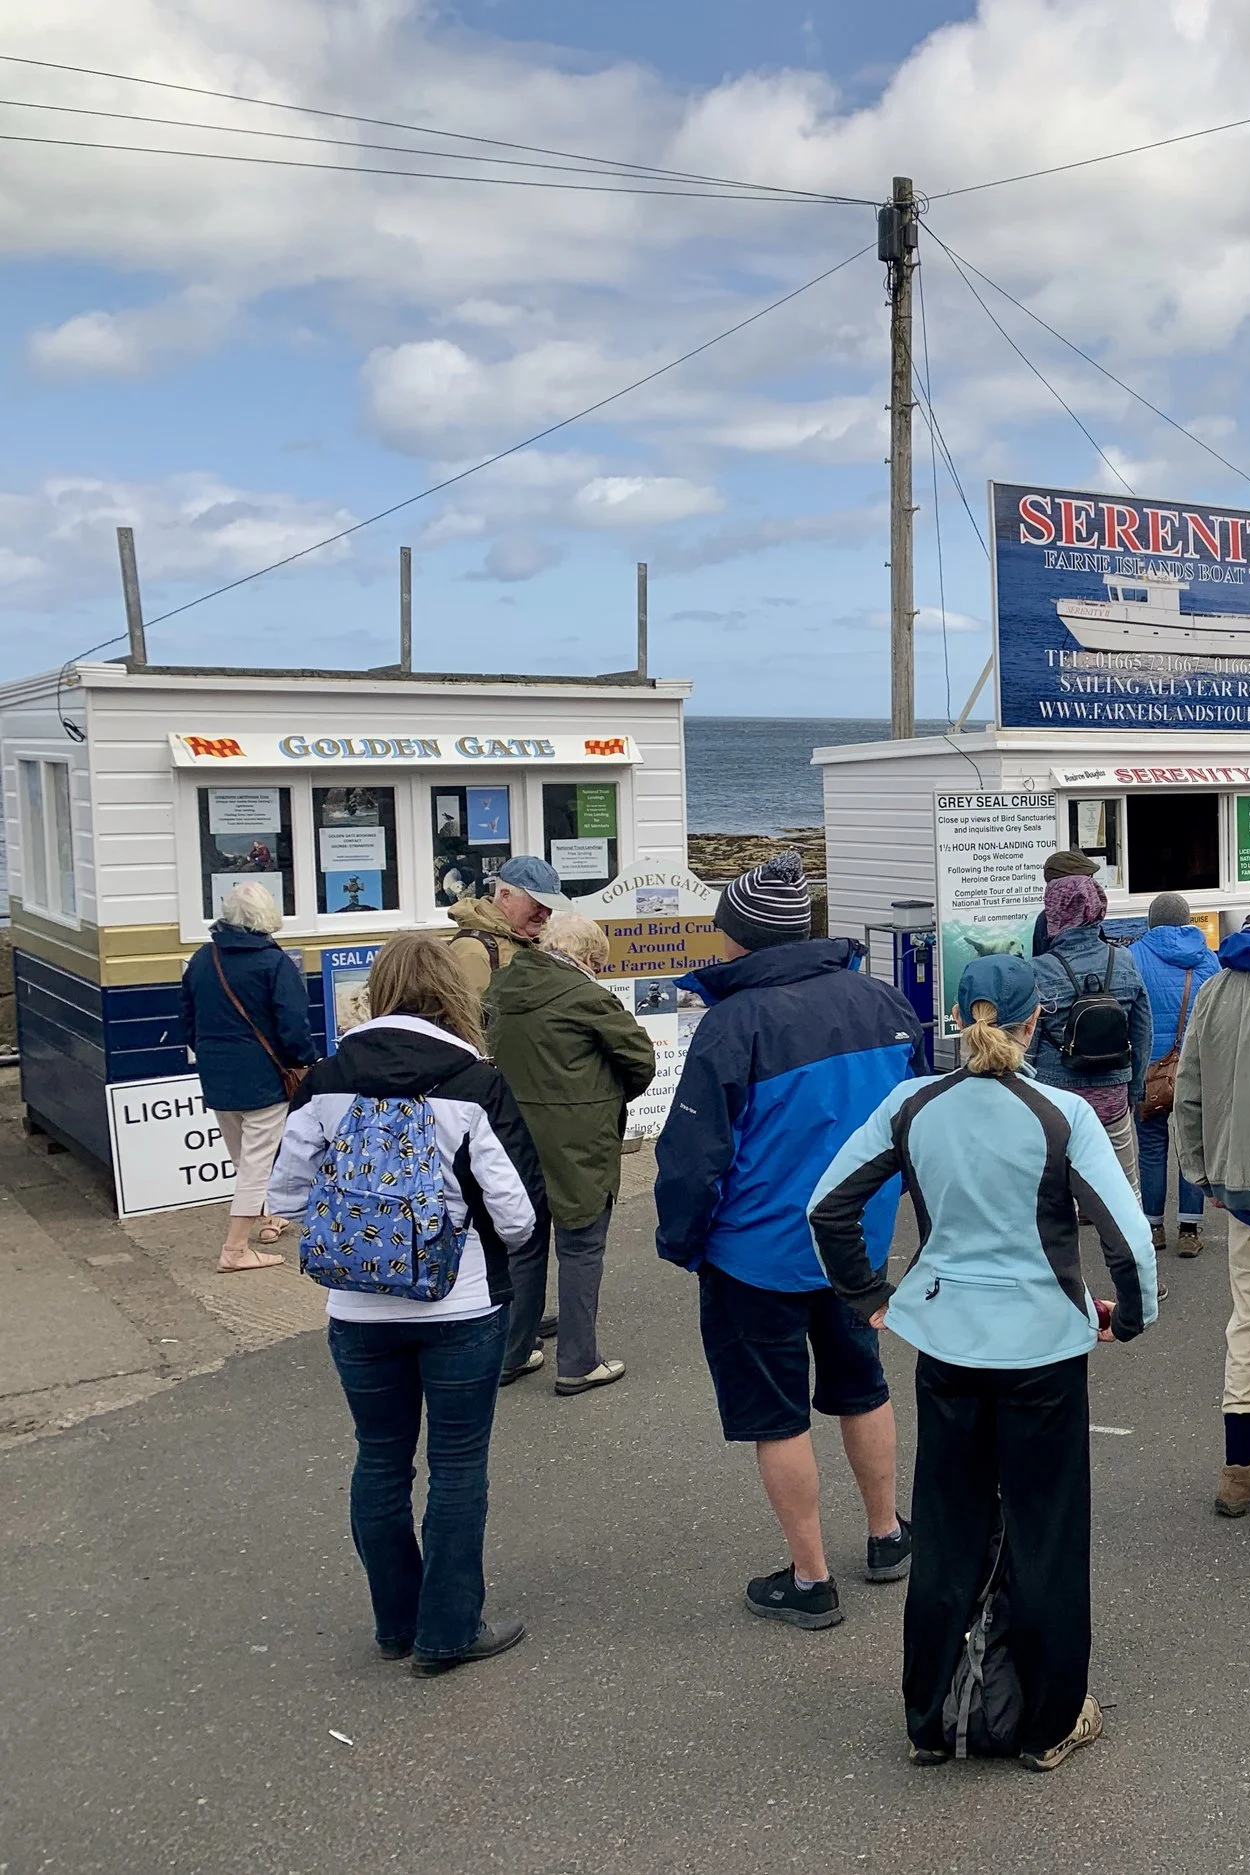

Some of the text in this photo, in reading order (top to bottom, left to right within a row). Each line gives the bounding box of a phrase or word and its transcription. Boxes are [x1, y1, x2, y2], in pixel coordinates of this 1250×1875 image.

[1044, 550, 1110, 573] FARNE
[1115, 556, 1194, 581] ISLANDS
[1199, 563, 1244, 584] BOAT
[1045, 650, 1090, 668] TEL:
[1095, 652, 1142, 670] 01665
[1148, 654, 1200, 673] 721667
[1060, 675, 1139, 694] SAILING
[1145, 680, 1181, 695] ALL
[1184, 680, 1232, 697] YEAR
[278, 735, 556, 759] GOLDEN GATE
[938, 795, 1056, 809] GREY SEAL CRUISE
[938, 816, 959, 824] Close
[960, 817, 970, 825] up
[971, 815, 991, 823] views
[1001, 814, 1015, 822] Bird
[1016, 813, 1056, 822] Sanctuaries
[953, 823, 1042, 835] and inquisitive Grey Seals
[952, 843, 976, 852] HOUR
[978, 841, 1034, 851] NON-LANDING
[1035, 840, 1056, 848] TOUR
[973, 852, 1024, 862] Dogs Welcome
[947, 863, 1022, 875] Following the route of
[961, 873, 1036, 884] Heroine Grace Darling
[602, 873, 711, 904] GOLDEN GATE
[954, 888, 988, 898] Complete
[989, 887, 1005, 895] Tour
[1005, 886, 1013, 894] of
[1023, 885, 1031, 893] of
[1032, 885, 1044, 893] the
[951, 897, 1021, 908] National Trust Farne
[973, 912, 1029, 922] Full commentary
[614, 921, 680, 937] and Bird
[626, 939, 685, 954] Around
[331, 951, 363, 967] SEAL
[620, 959, 666, 973] Farne
[608, 985, 630, 993] Time
[664, 1050, 676, 1059] to
[639, 1105, 667, 1116] route
